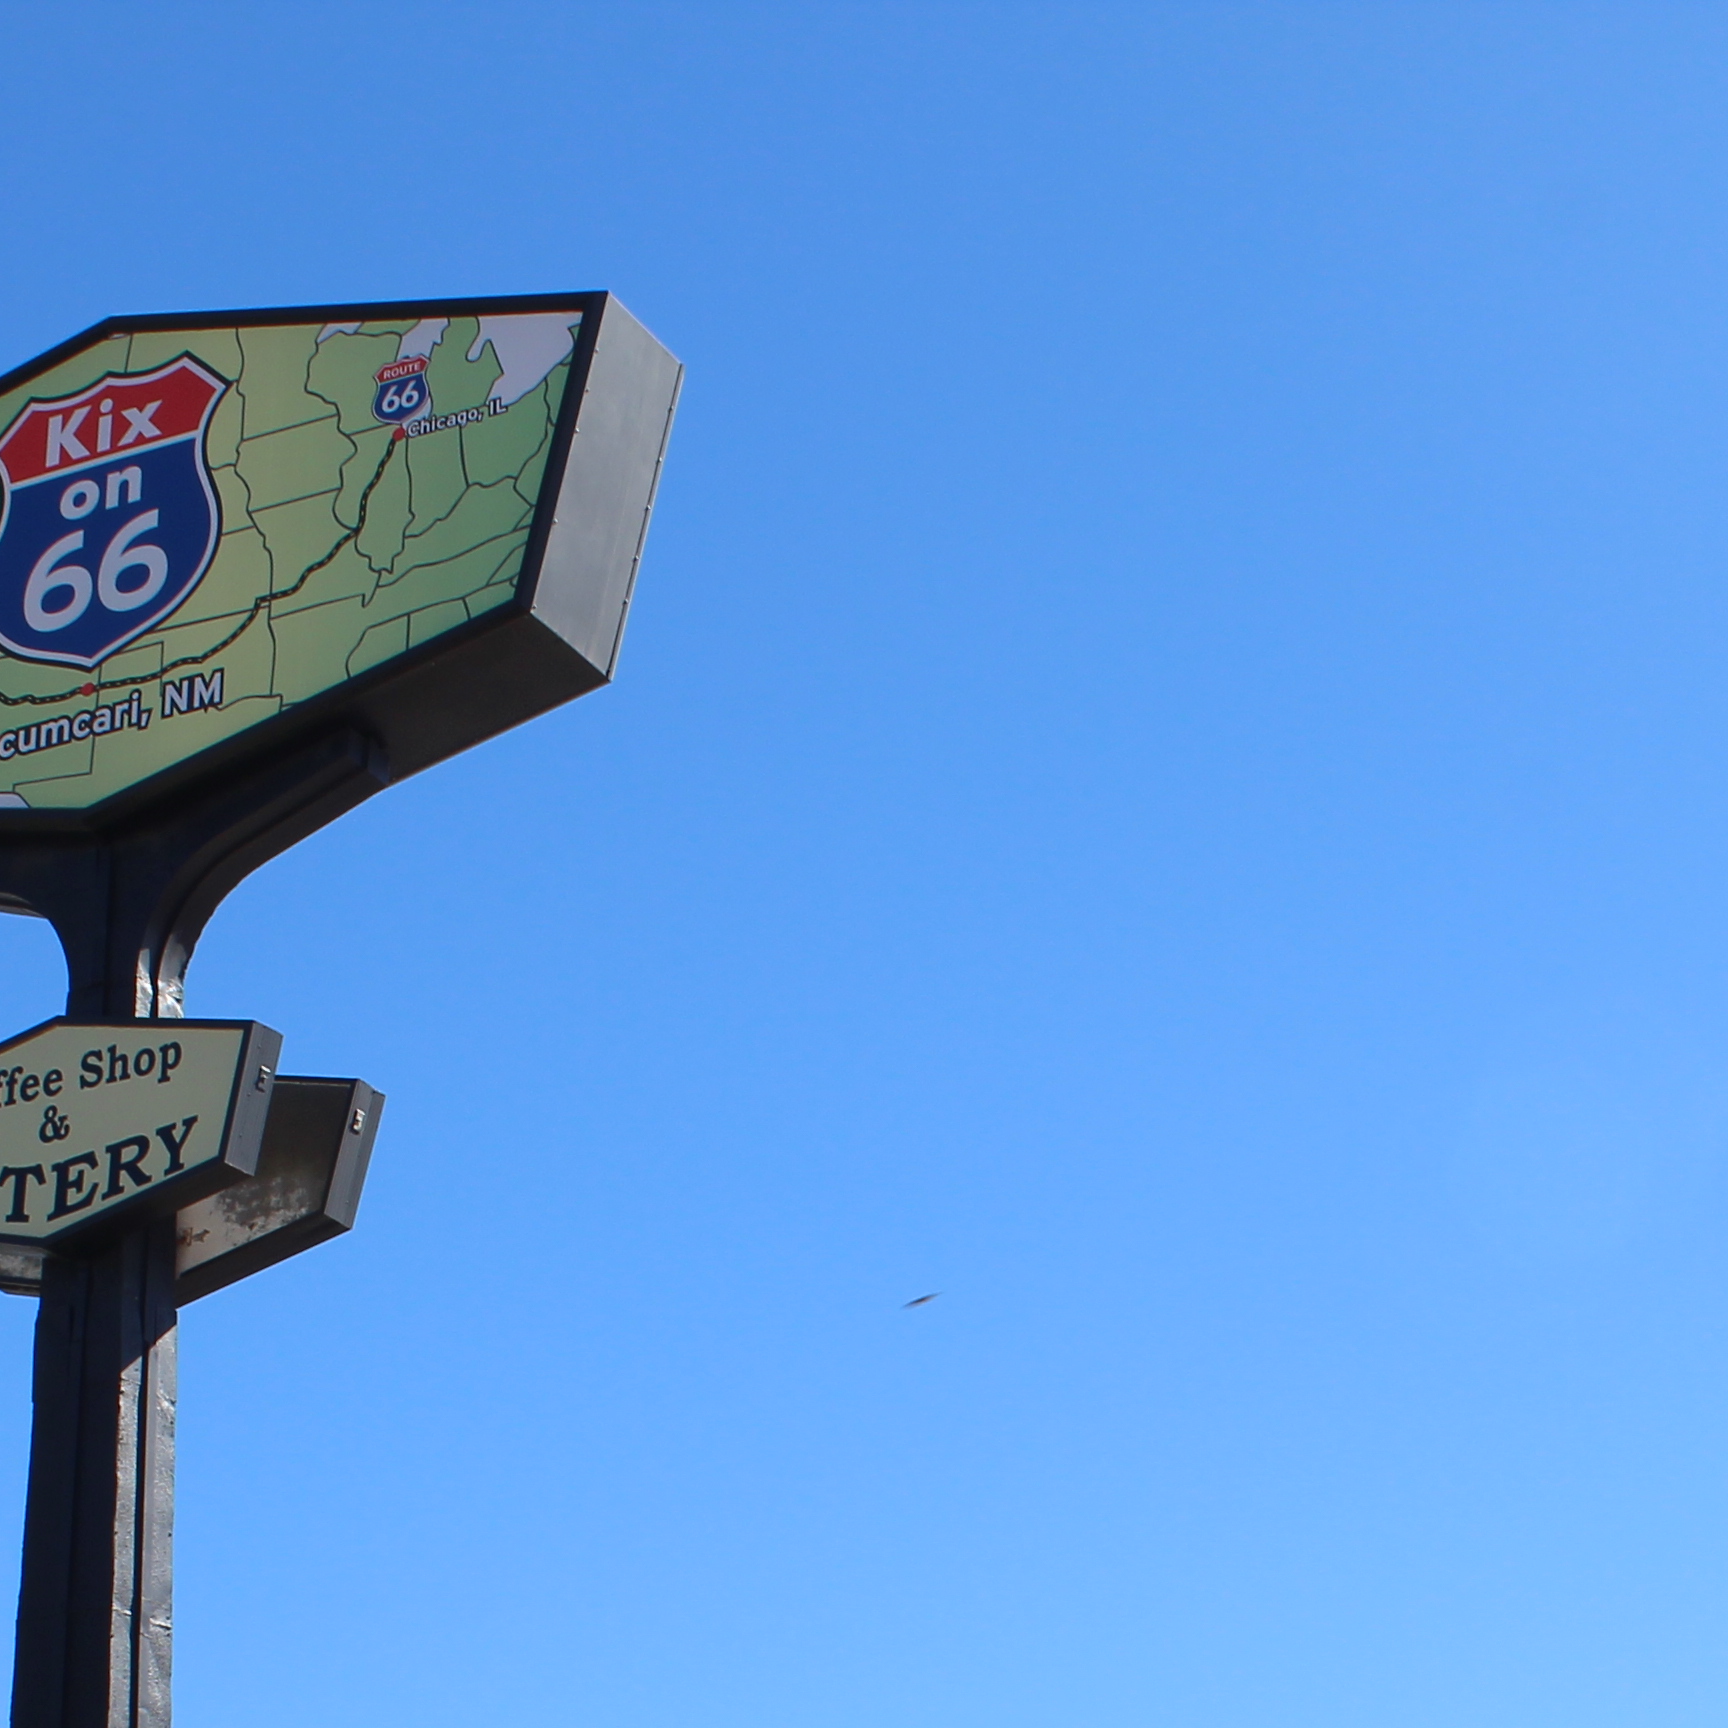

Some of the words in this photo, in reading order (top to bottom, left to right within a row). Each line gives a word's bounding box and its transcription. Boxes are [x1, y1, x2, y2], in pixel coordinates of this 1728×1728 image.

[383, 362, 421, 380] ROUTE
[381, 380, 419, 413] 66
[407, 407, 484, 437] Chicago,
[488, 397, 508, 417] IL
[45, 397, 164, 468] Kix
[59, 466, 143, 520] on
[23, 508, 168, 633] 66
[161, 668, 224, 720] NM
[79, 1040, 182, 1090] Shop
[38, 1105, 70, 1144] &
